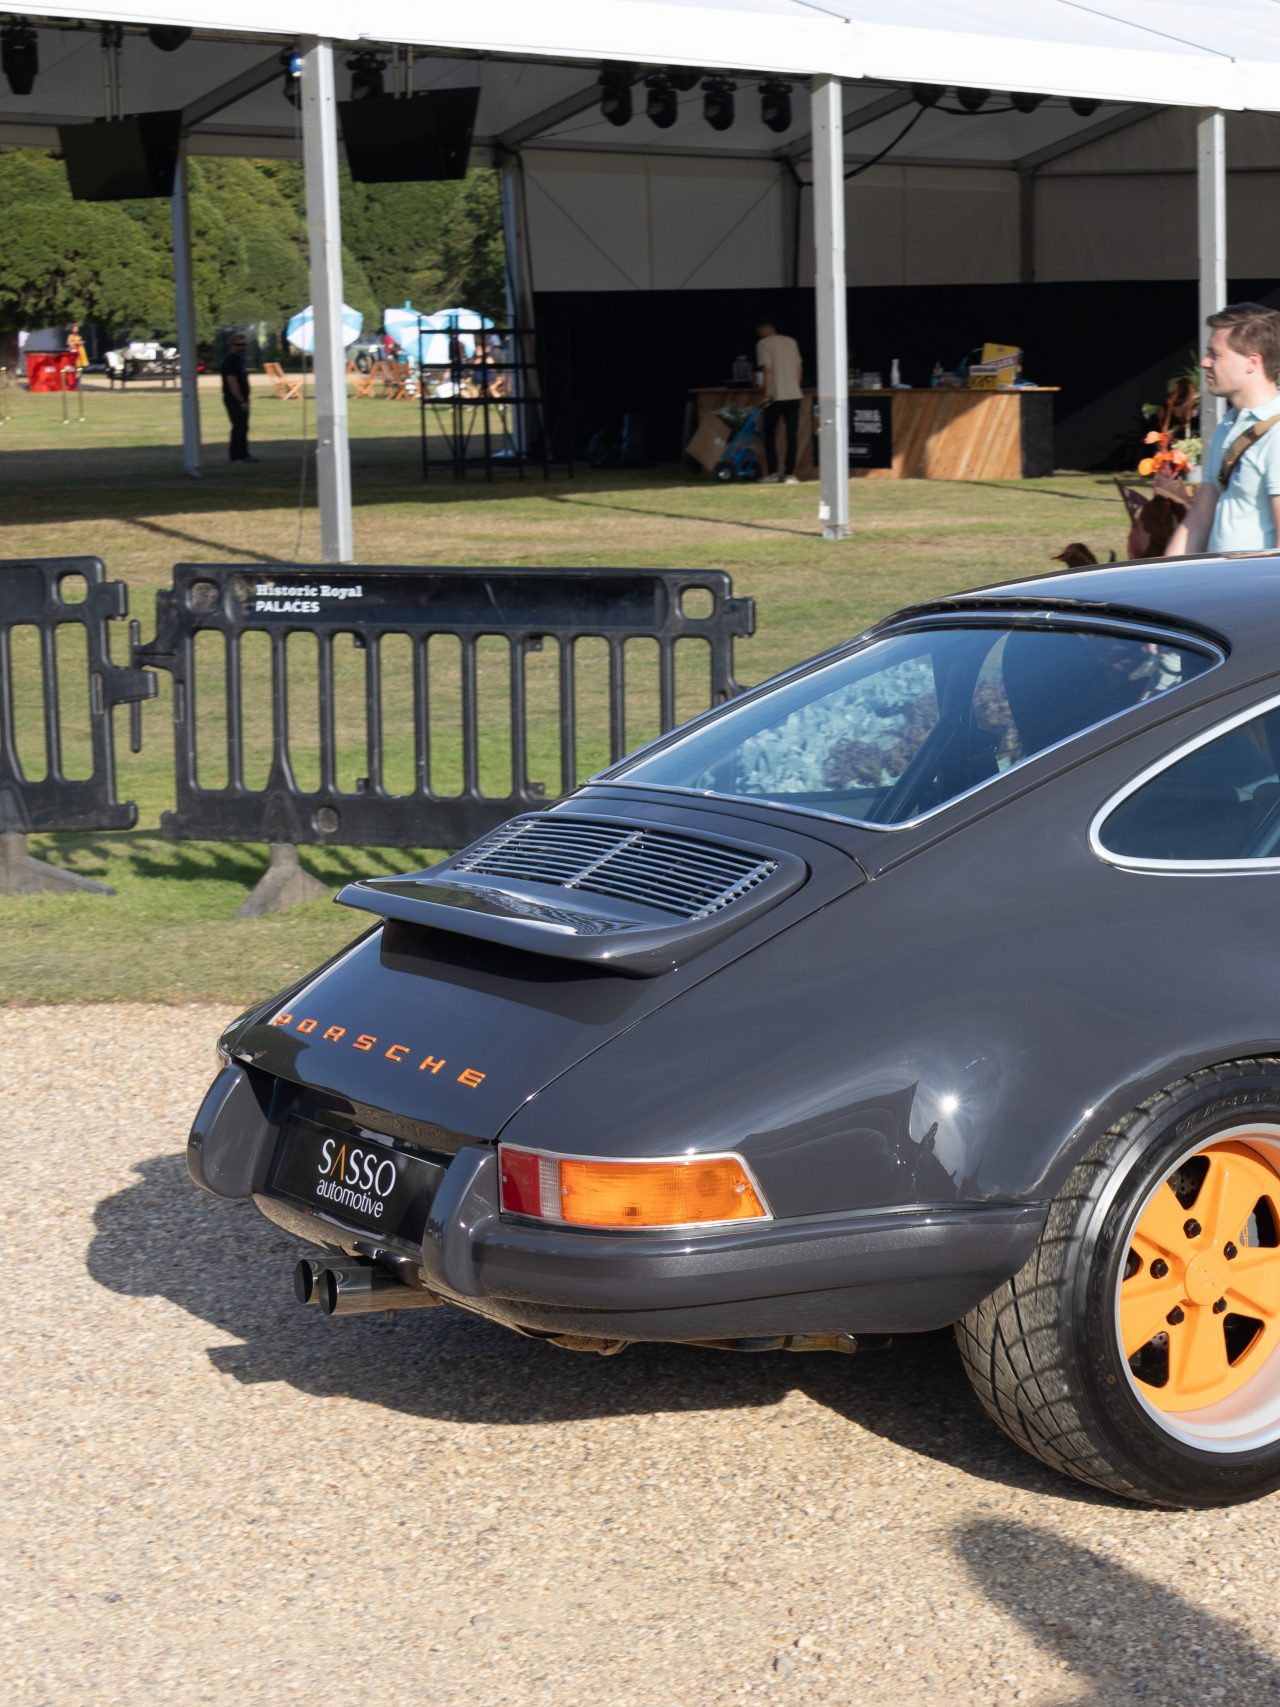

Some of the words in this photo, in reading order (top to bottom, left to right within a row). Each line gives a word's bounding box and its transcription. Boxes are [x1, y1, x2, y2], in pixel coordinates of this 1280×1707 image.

[255, 584, 318, 597] Historic
[319, 585, 363, 600] Royal
[255, 599, 320, 613] PALACES
[272, 1013, 487, 1088] PORSCHE
[318, 1138, 396, 1197] SASSO
[316, 1179, 384, 1218] automotive
